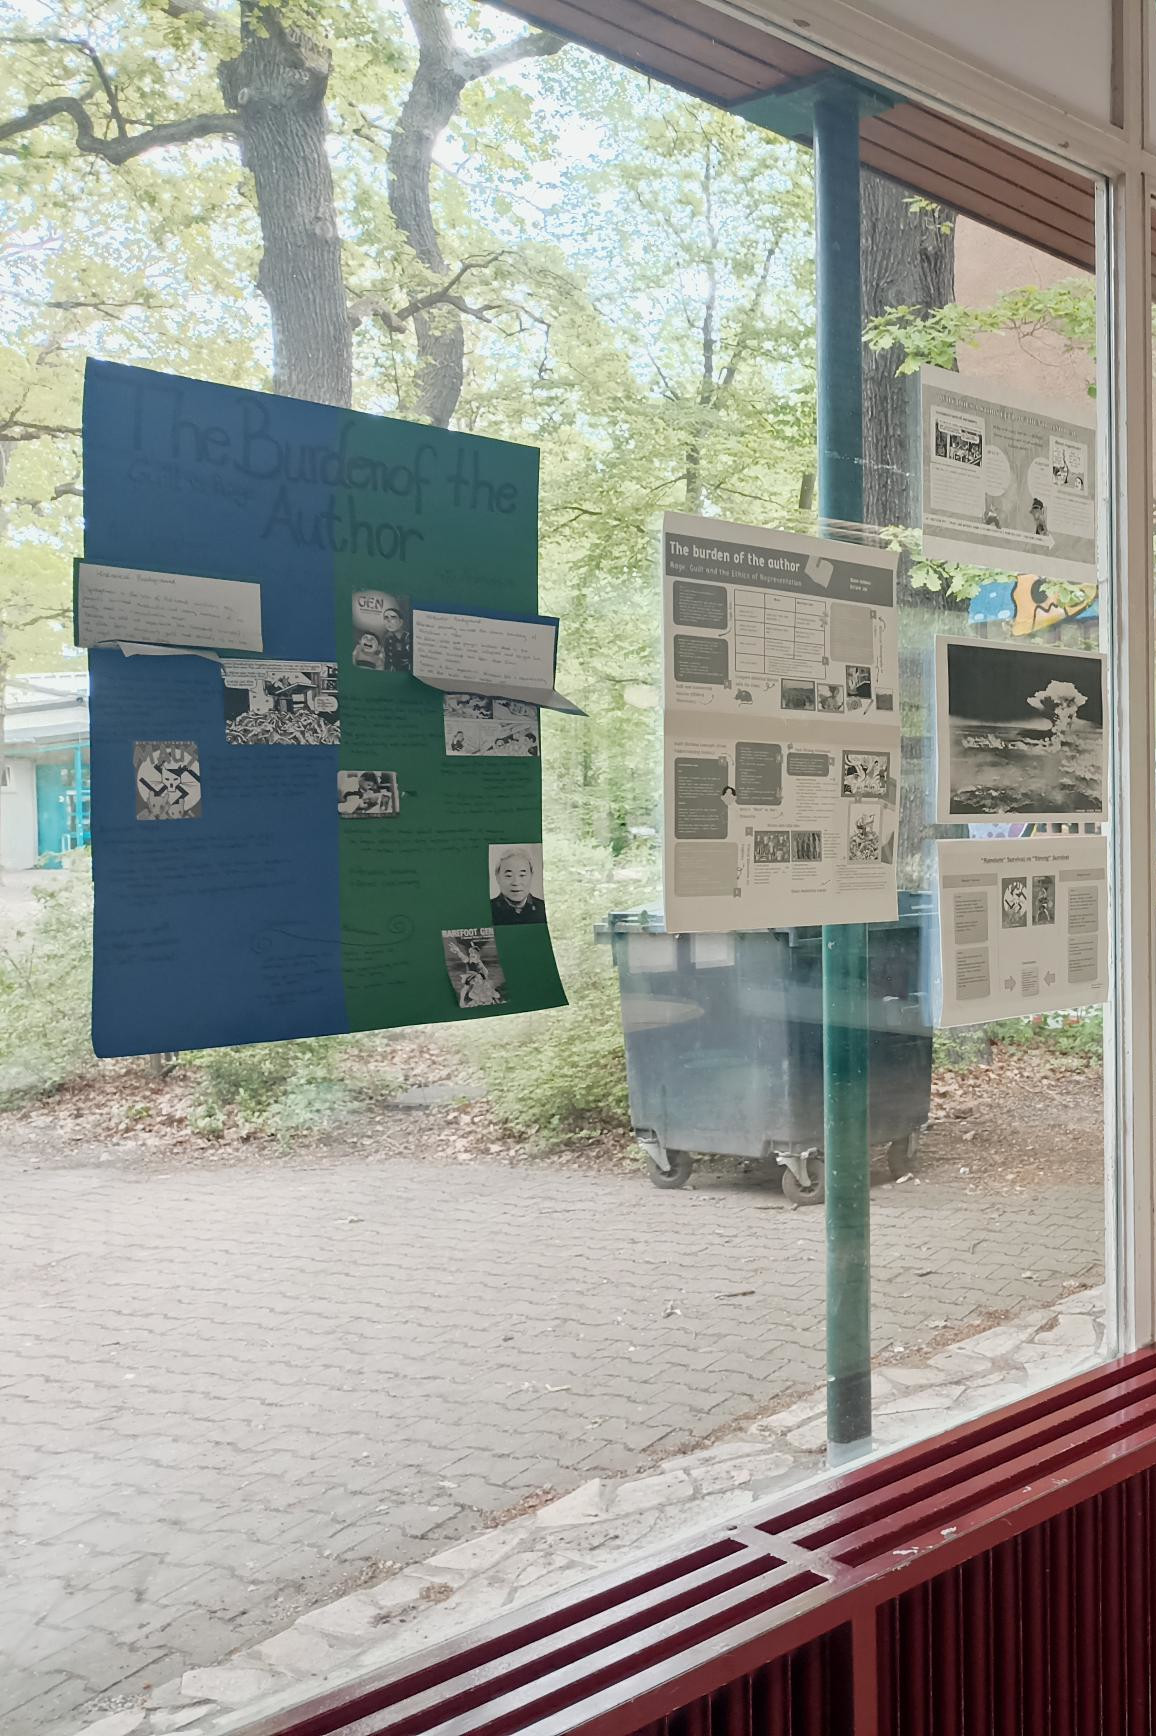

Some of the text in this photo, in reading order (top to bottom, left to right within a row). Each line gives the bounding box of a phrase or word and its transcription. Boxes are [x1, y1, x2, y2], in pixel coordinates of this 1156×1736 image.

[446, 447, 519, 515] the
[259, 484, 425, 563] Author
[670, 541, 800, 572] The burden of the author
